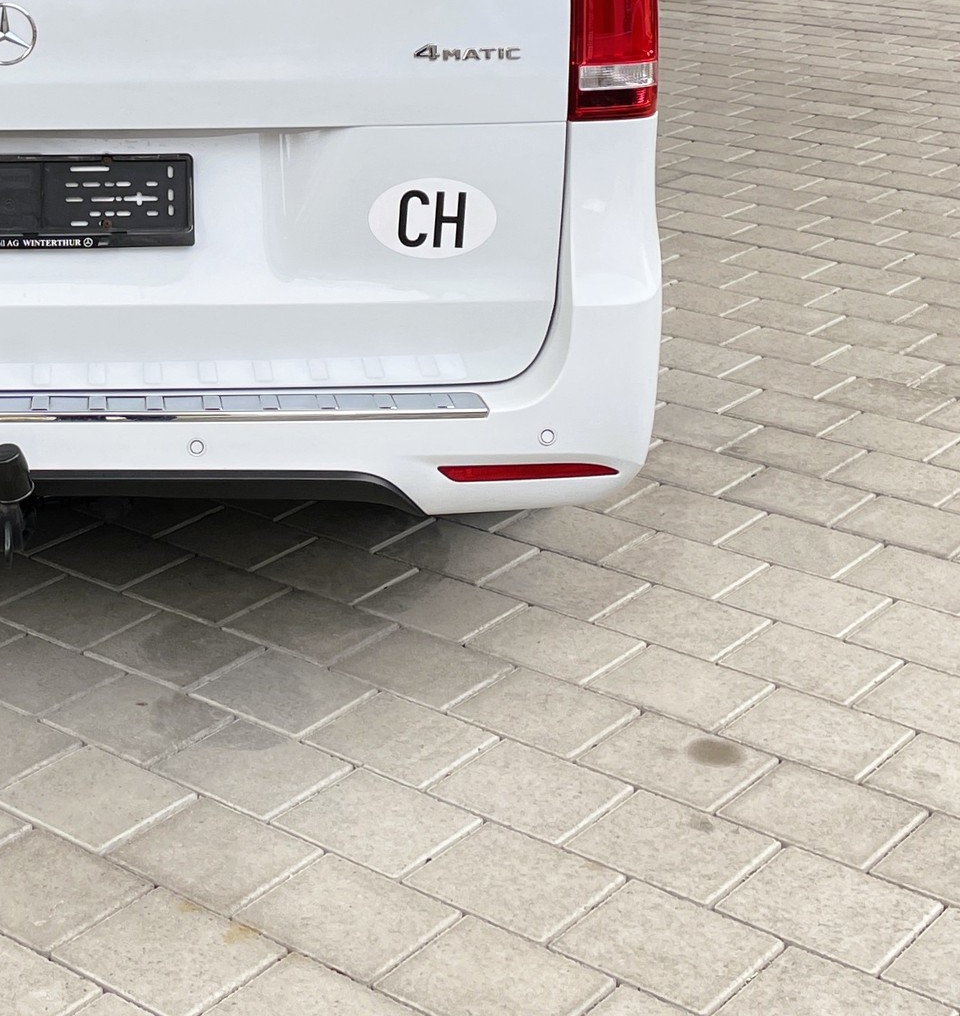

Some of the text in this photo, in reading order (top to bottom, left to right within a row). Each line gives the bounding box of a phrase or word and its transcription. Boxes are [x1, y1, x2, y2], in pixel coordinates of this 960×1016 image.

[413, 42, 521, 61] 4MATIC
[397, 189, 467, 249] CH
[6, 239, 20, 247] AG
[22, 239, 82, 247] WINTERTHUR
